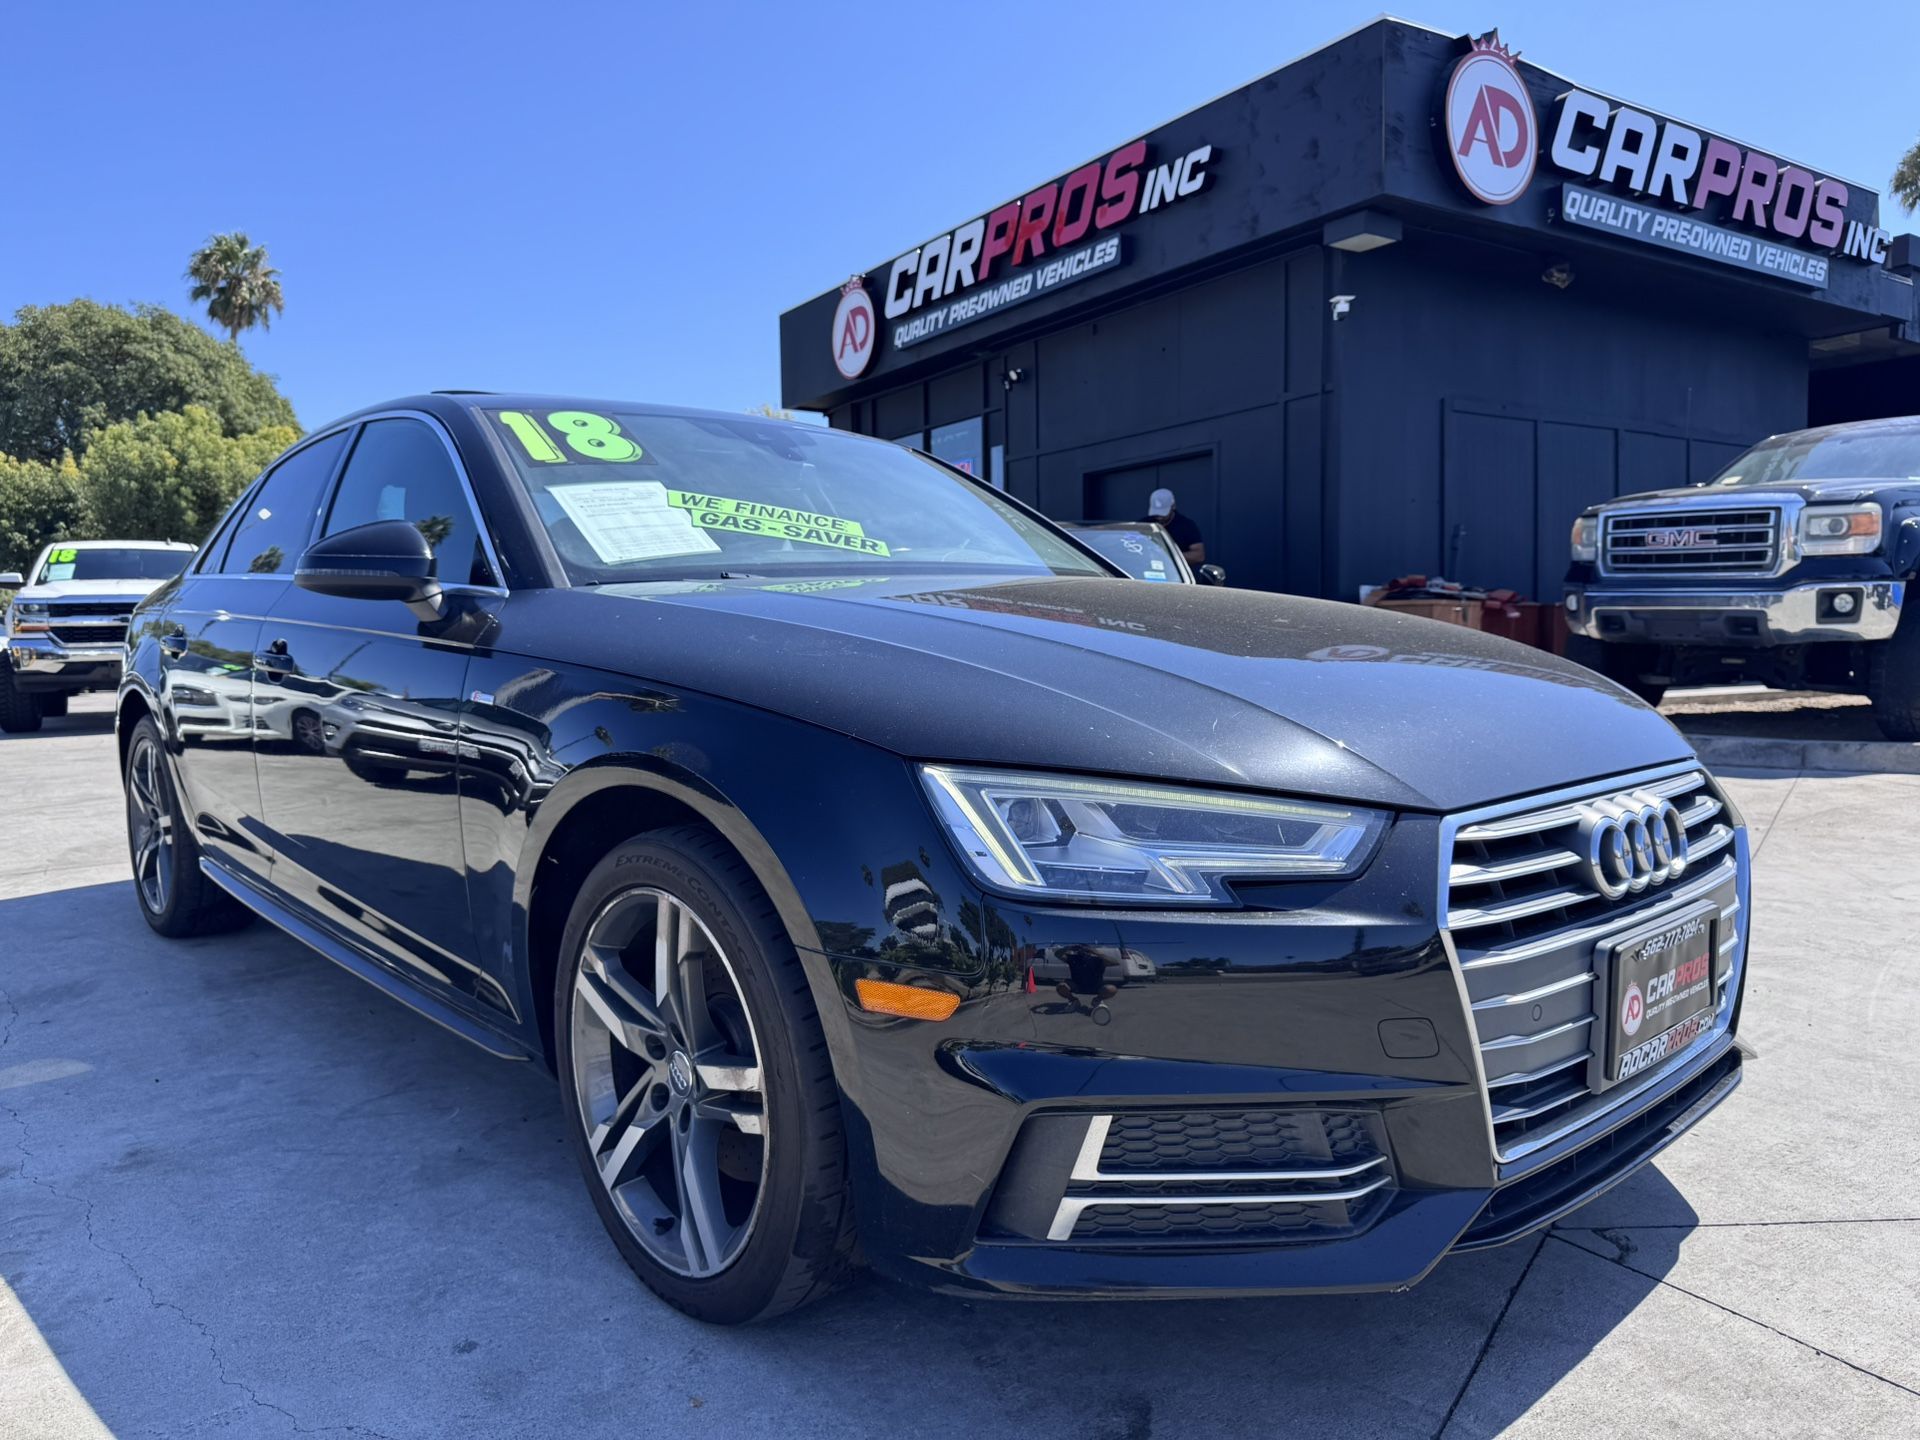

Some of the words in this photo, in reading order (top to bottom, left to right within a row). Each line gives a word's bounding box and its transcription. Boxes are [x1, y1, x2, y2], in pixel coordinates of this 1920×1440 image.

[1457, 83, 1528, 169] AD
[1139, 145, 1212, 213] INC
[1565, 191, 1650, 232] QUALITY
[1755, 243, 1828, 282] VEHICLES
[1843, 220, 1890, 264] INC
[893, 308, 947, 347] QUALITY
[1036, 237, 1119, 290] VEHICLES
[838, 304, 871, 360] AD
[498, 410, 643, 464] 18
[681, 493, 726, 511] WE
[734, 501, 850, 533] FINANCE
[1645, 528, 1719, 548] GMC
[48, 549, 78, 564] 18
